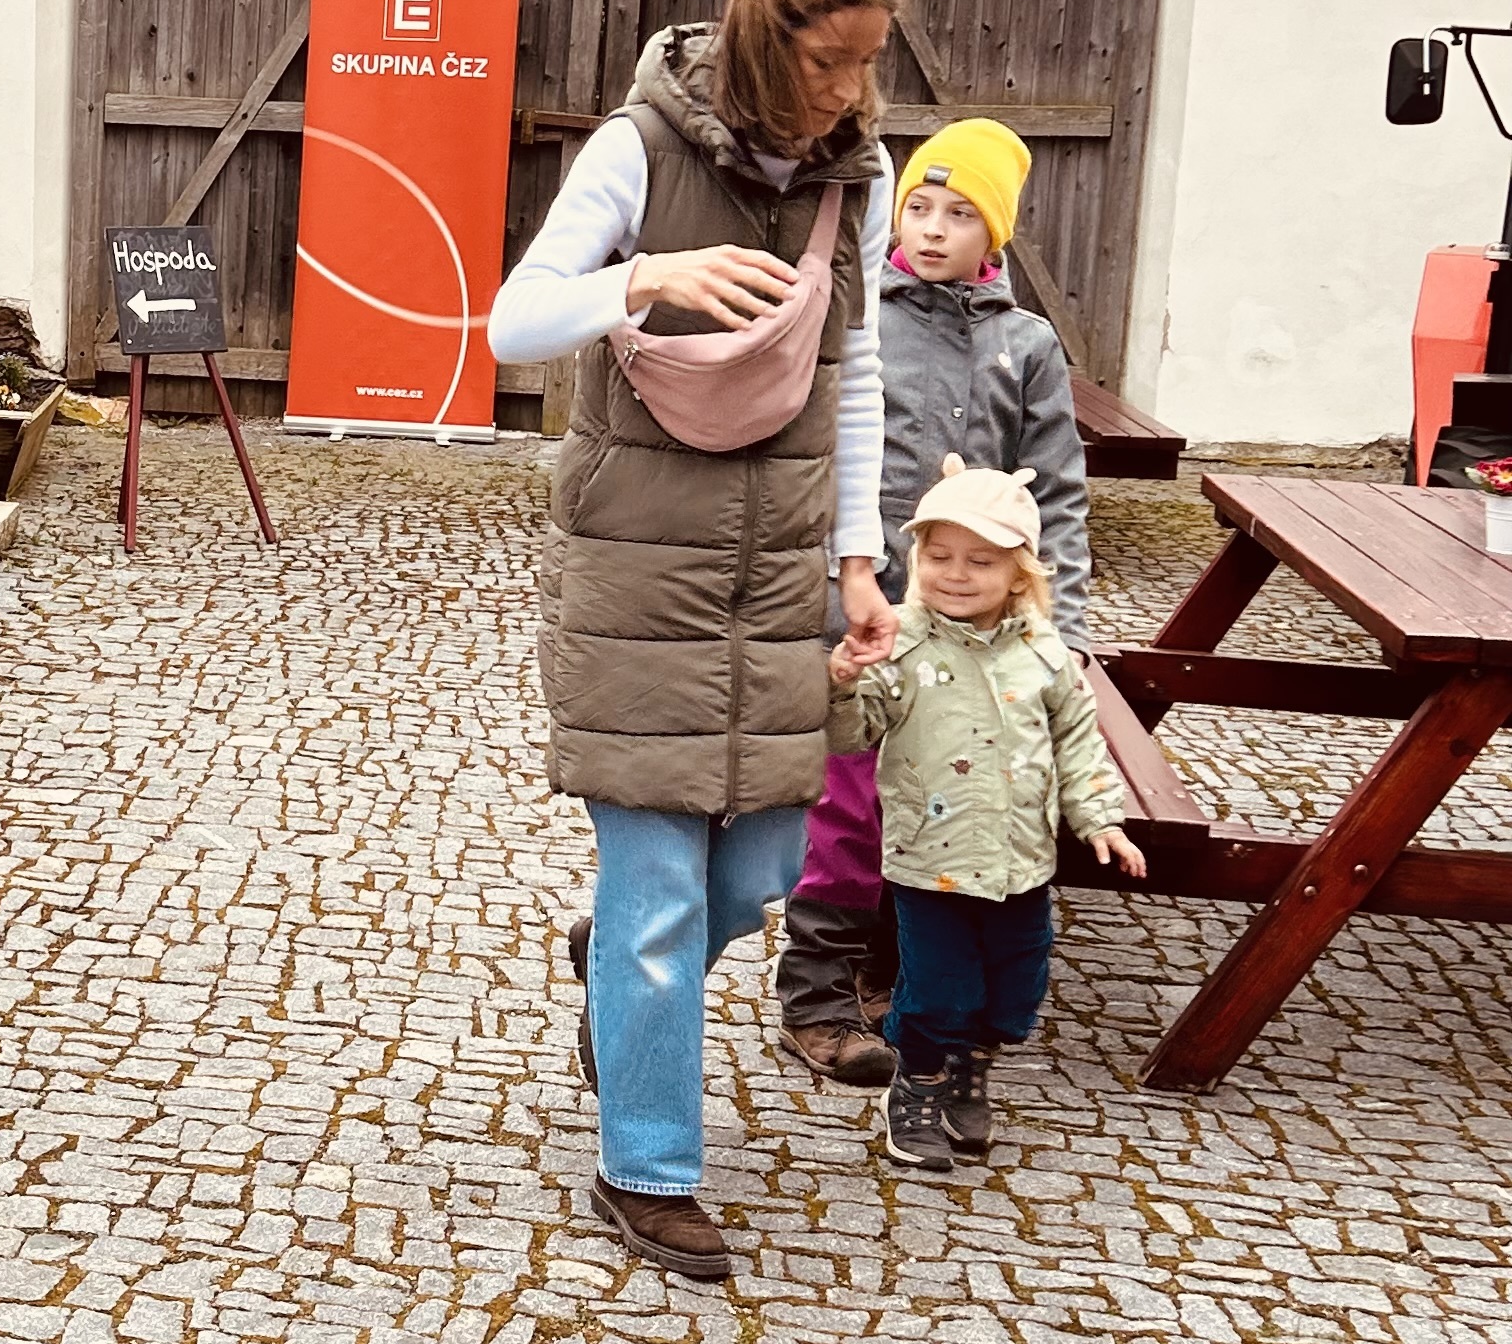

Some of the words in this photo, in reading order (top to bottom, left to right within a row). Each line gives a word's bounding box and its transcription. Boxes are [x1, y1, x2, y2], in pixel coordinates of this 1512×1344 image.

[331, 53, 436, 77] SKUPINA
[441, 52, 489, 79] ČEZ
[112, 239, 217, 286] Hospoda
